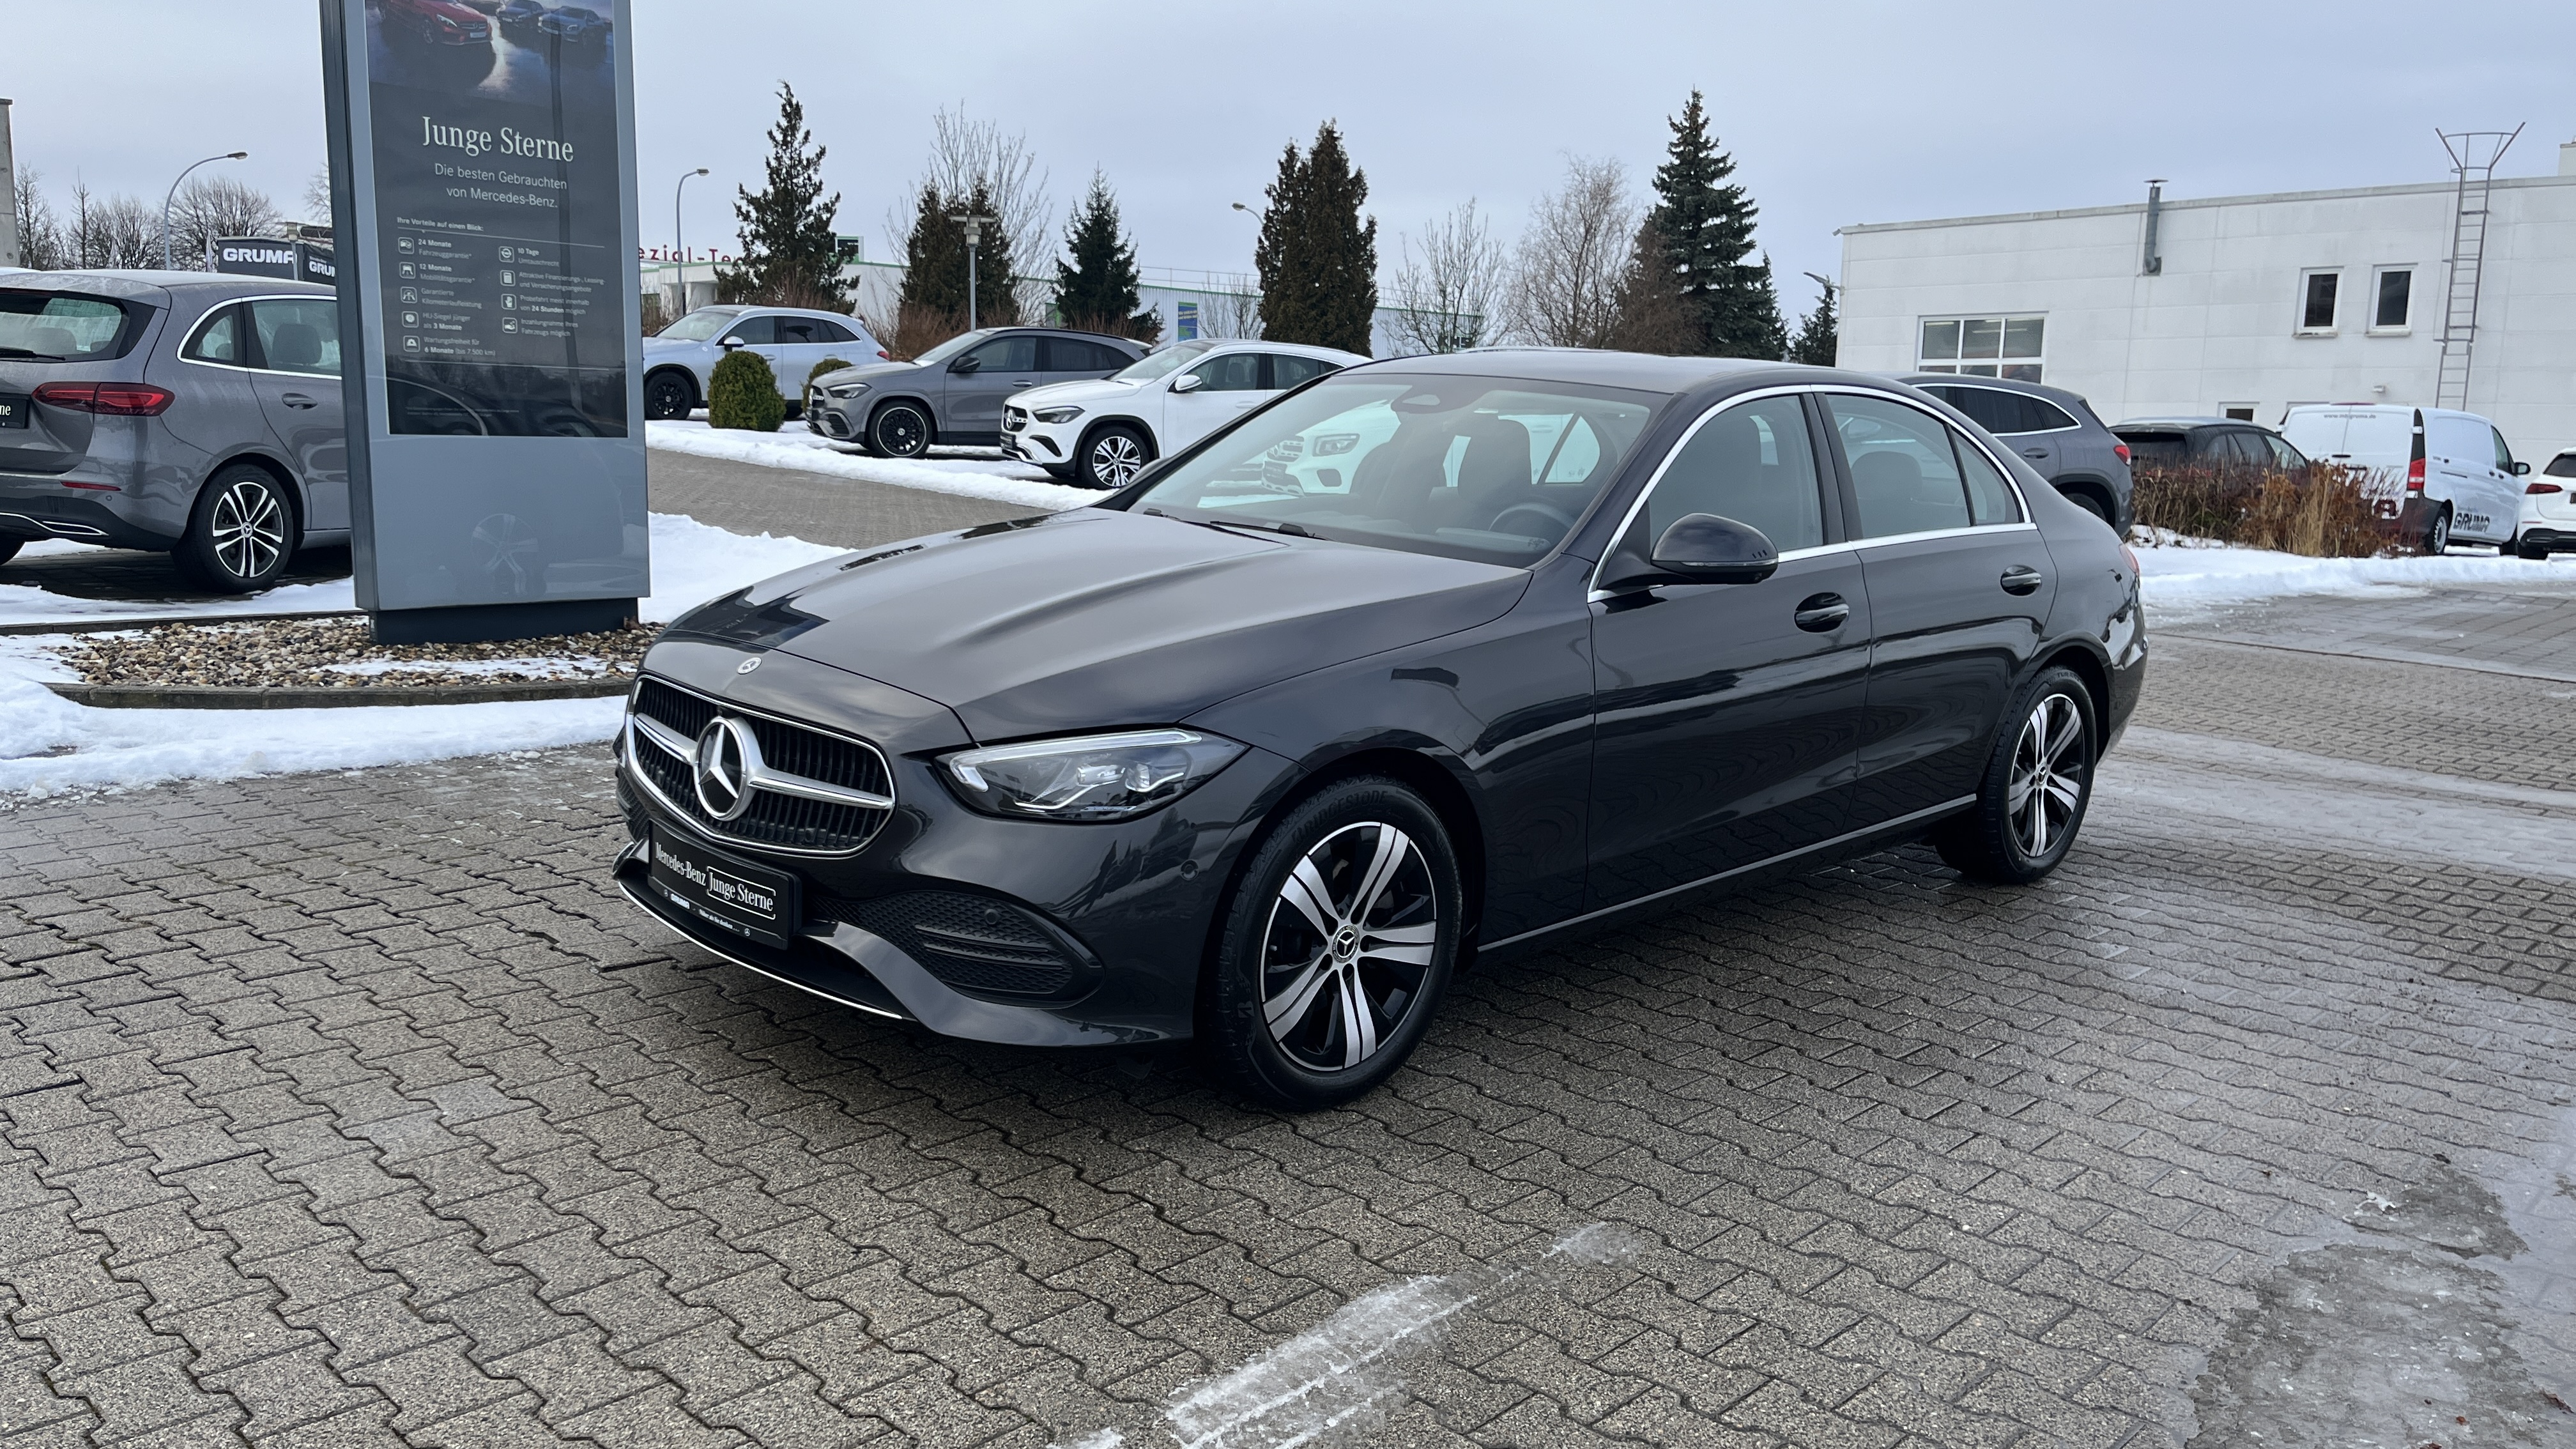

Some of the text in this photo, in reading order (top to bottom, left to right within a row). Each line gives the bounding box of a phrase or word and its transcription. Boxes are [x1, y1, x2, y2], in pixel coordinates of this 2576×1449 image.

[422, 116, 574, 162] Junge Sterne
[435, 163, 567, 190] Die besten Gebrauchten
[447, 188, 558, 208] von Mercedes-Benz.
[411, 218, 436, 227] Vorteile
[428, 240, 452, 248] Monate
[526, 248, 539, 256] Tage
[224, 248, 298, 264] GRUMA
[2453, 512, 2490, 533] GRUMA
[656, 842, 774, 912] Mercedes-Benz Junge Sterne
